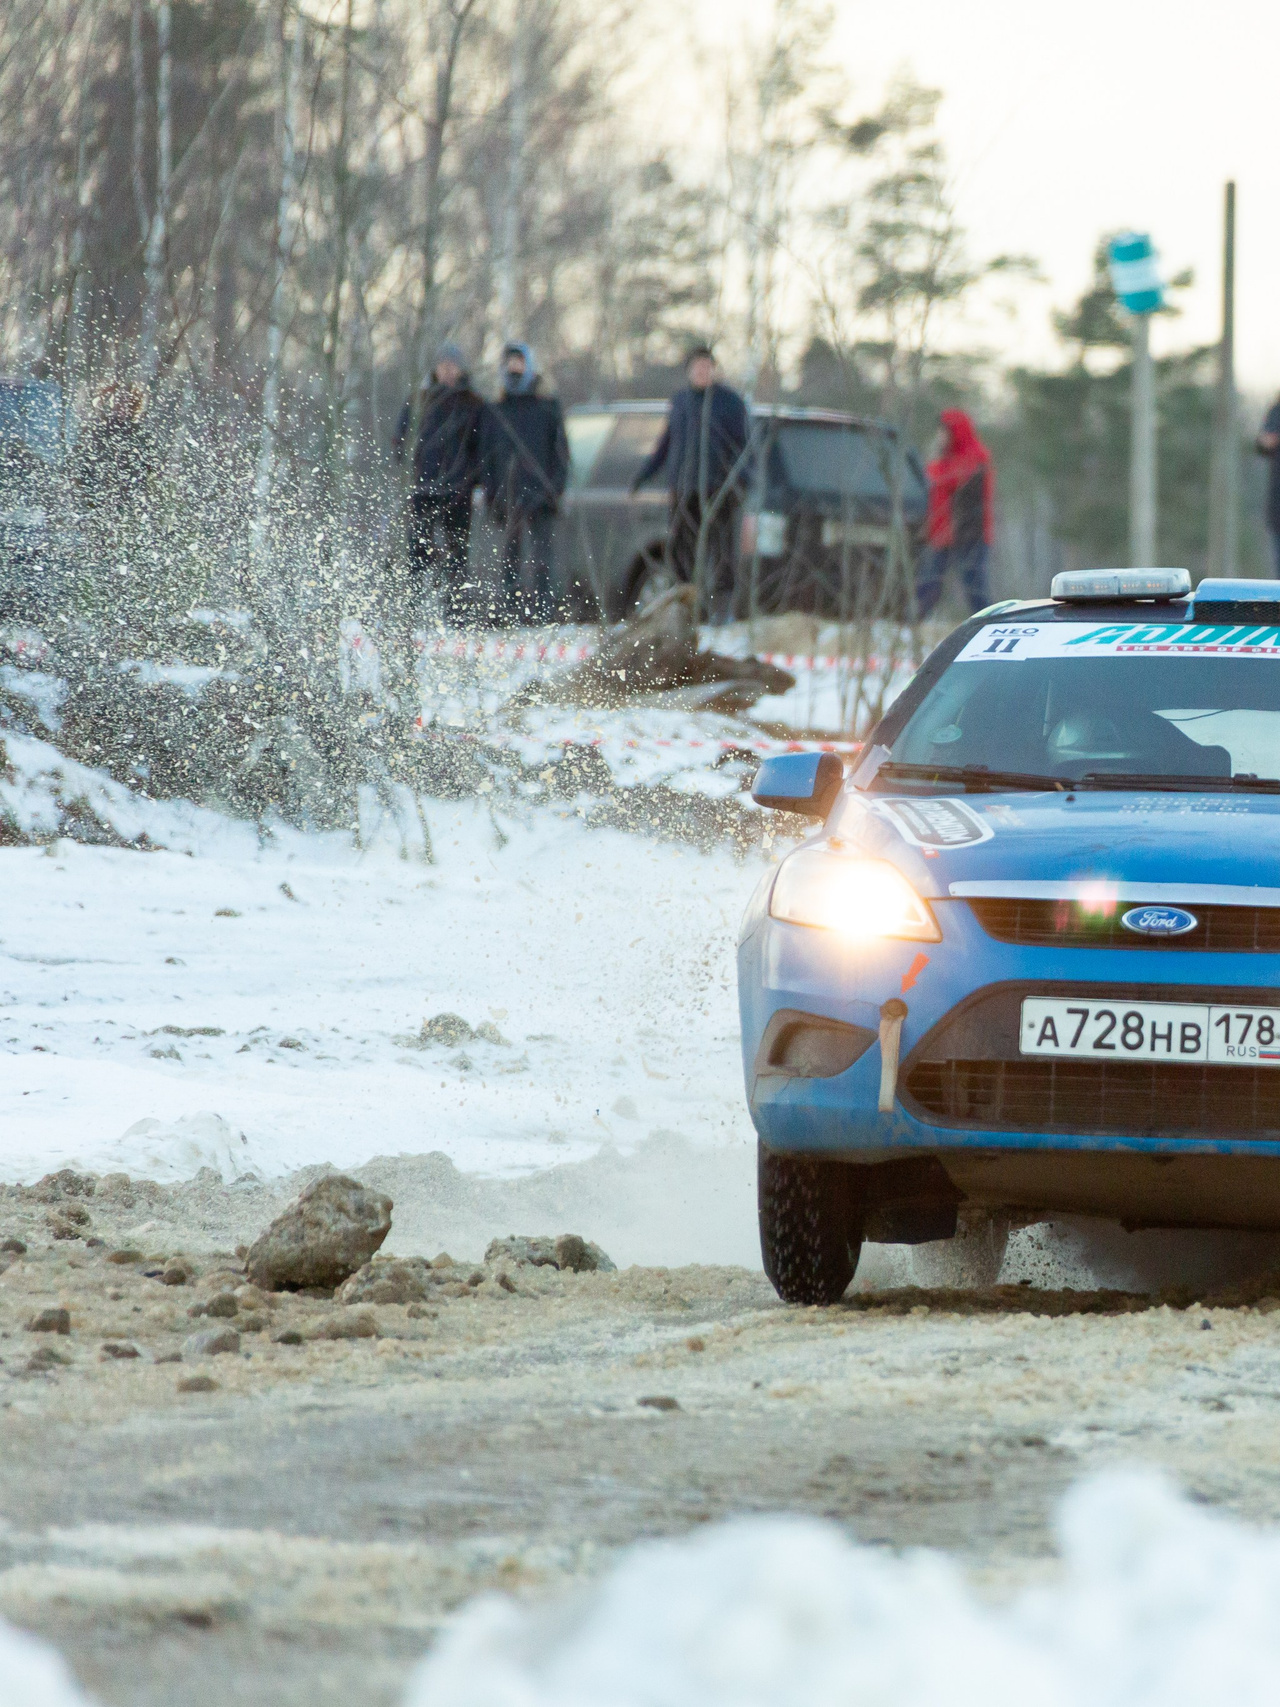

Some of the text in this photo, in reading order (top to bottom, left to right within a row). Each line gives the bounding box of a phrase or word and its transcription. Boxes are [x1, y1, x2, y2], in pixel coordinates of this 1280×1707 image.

[991, 627, 1039, 635] NEO
[982, 638, 1021, 653] 11
[1139, 911, 1178, 928] Ford
[1215, 1013, 1275, 1045] 178
[1226, 1045, 1258, 1058] RUS
